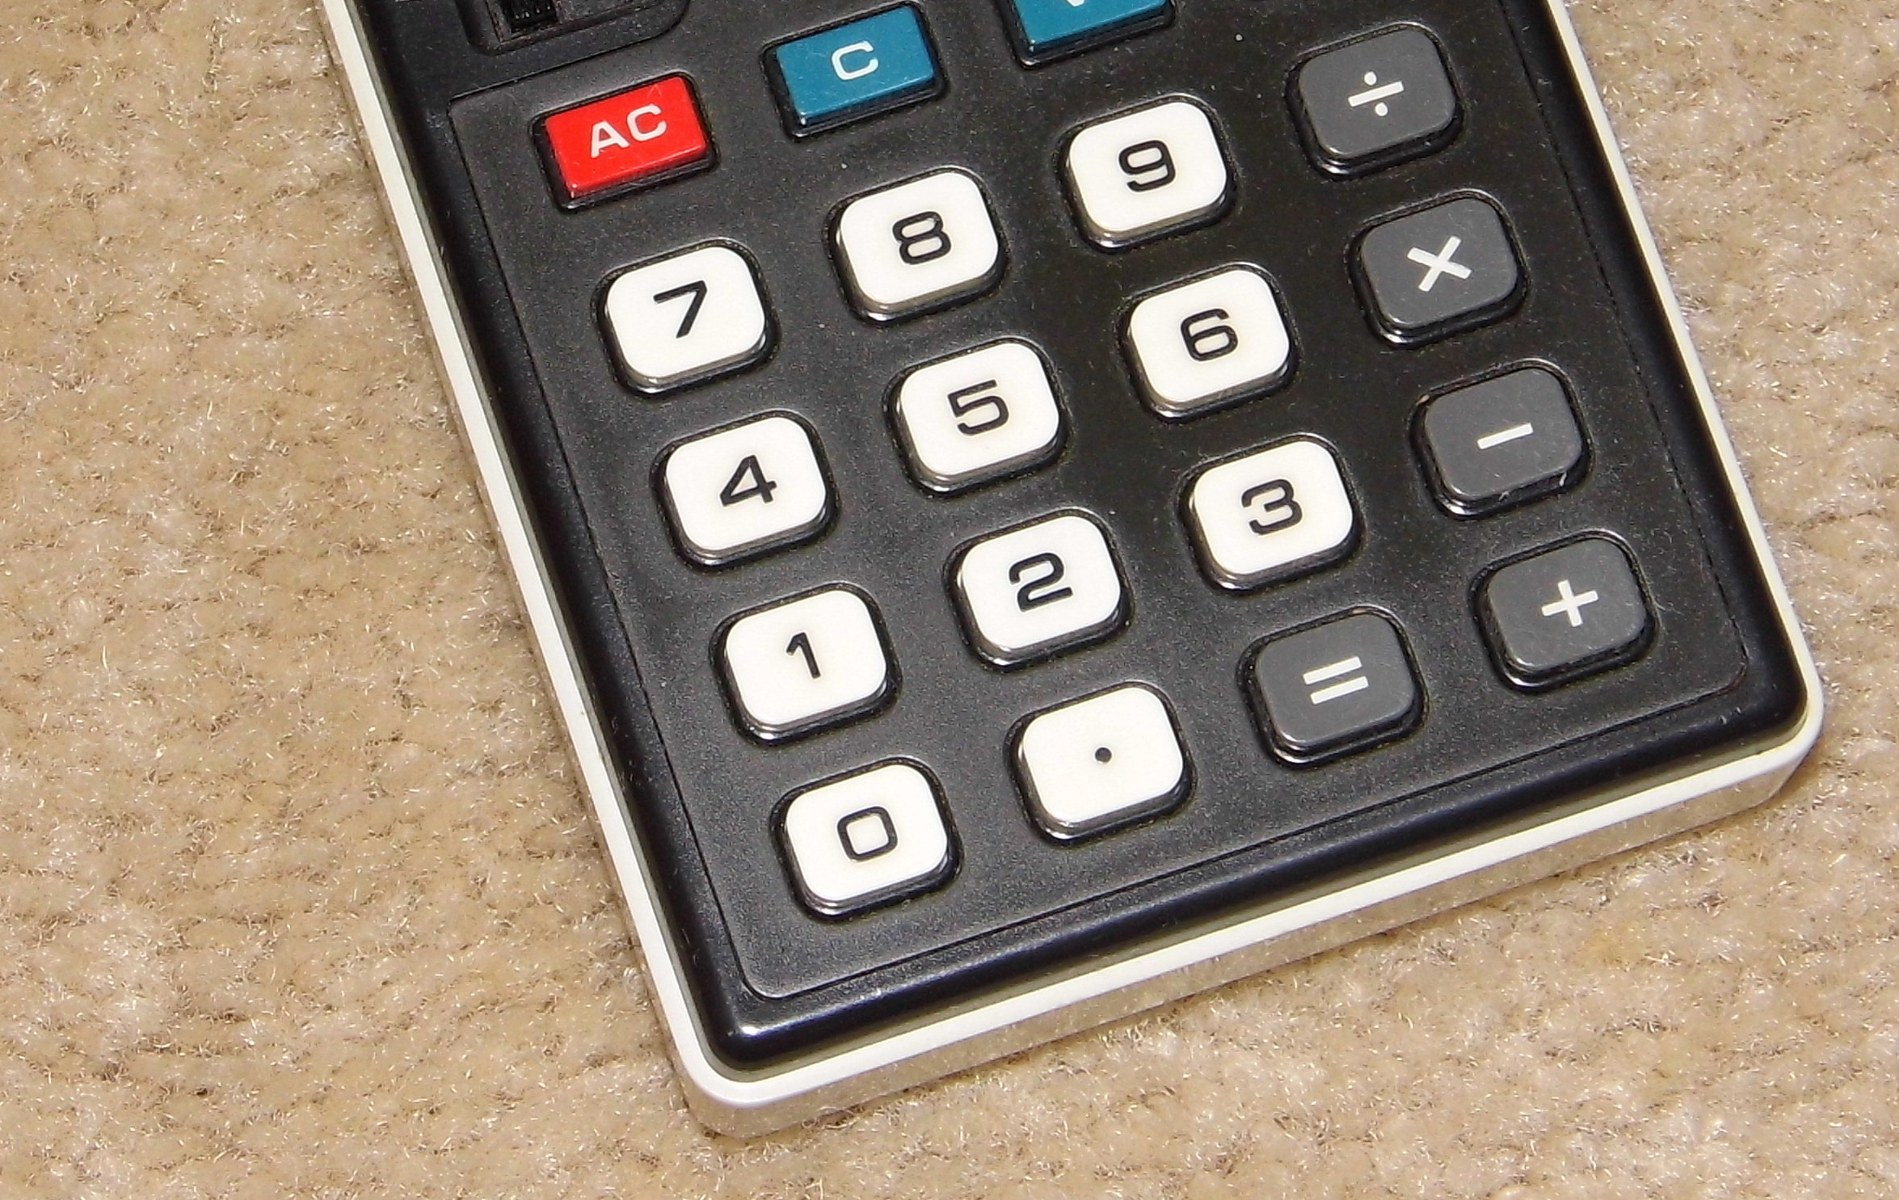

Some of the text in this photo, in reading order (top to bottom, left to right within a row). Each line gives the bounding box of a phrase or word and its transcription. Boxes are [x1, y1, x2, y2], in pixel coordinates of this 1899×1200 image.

[831, 40, 879, 81] C
[591, 103, 667, 158] AC
[1118, 139, 1176, 193] 9
[892, 211, 952, 265] 8
[653, 280, 708, 339] 7
[1180, 308, 1239, 362] 6
[947, 379, 1009, 435] 5
[719, 454, 777, 507] 4
[1241, 478, 1303, 536] 3
[1008, 552, 1073, 611] 2
[786, 632, 821, 679] 1
[836, 806, 898, 862] 0
